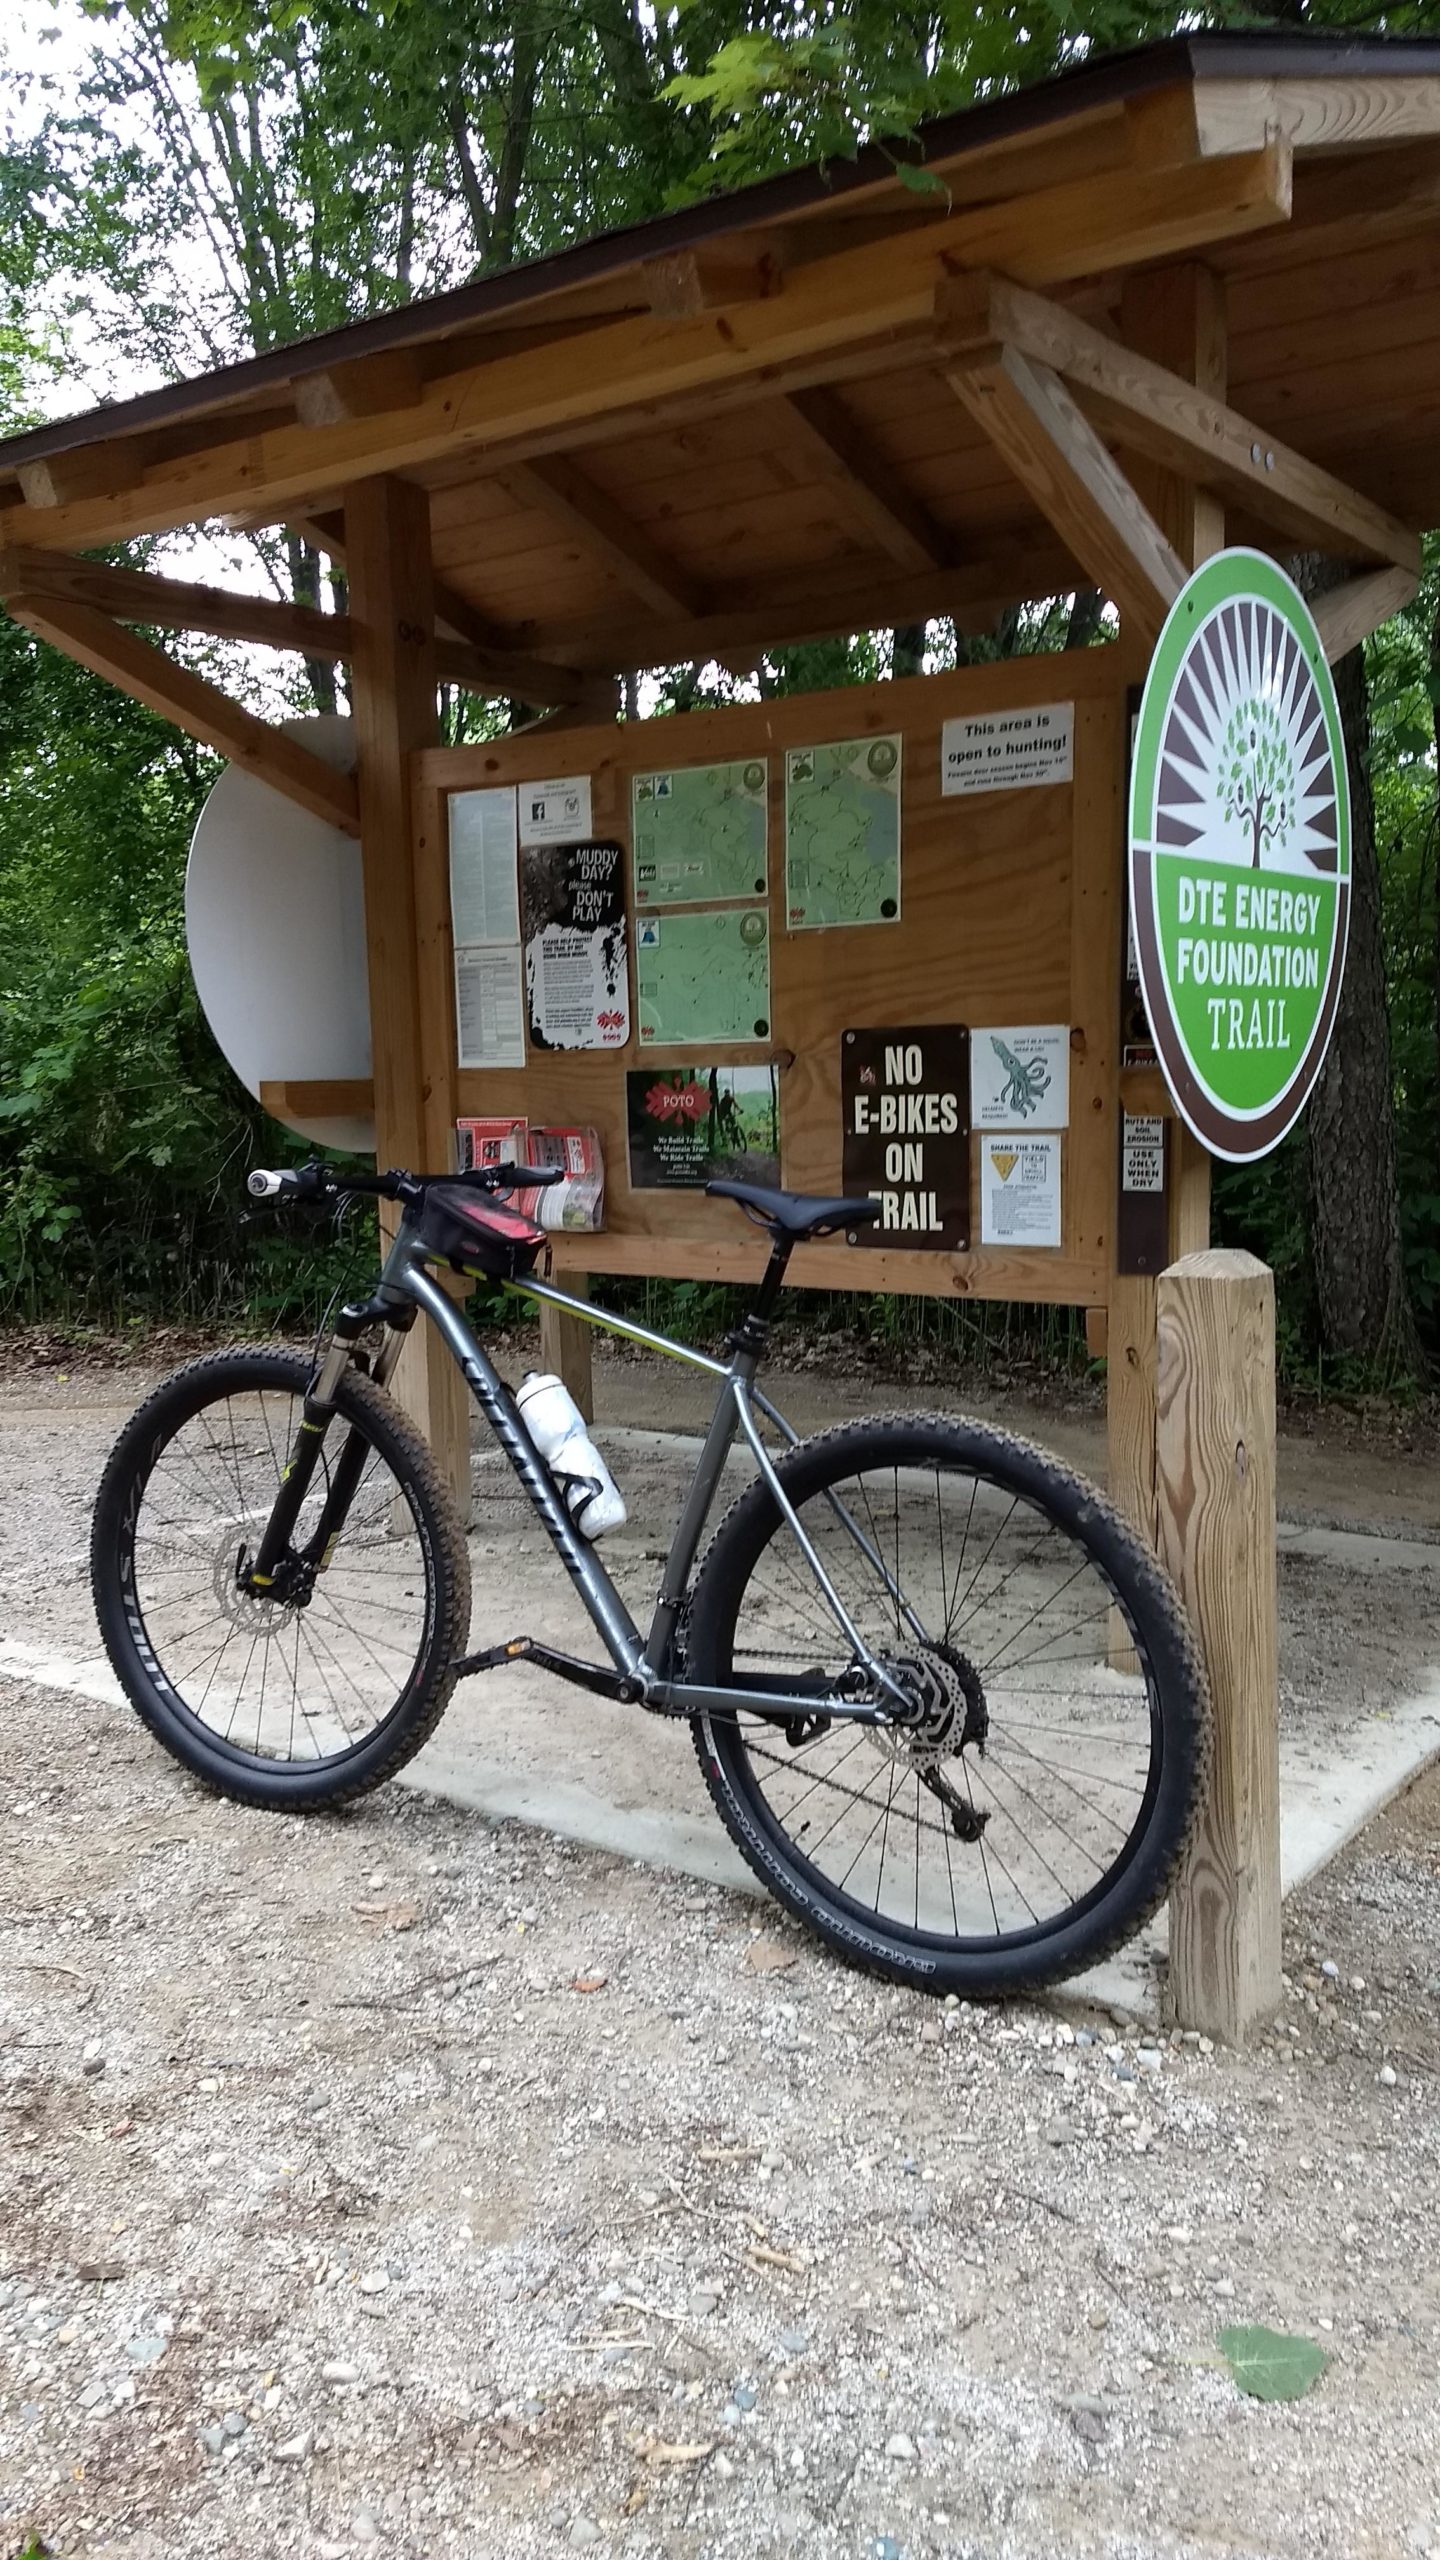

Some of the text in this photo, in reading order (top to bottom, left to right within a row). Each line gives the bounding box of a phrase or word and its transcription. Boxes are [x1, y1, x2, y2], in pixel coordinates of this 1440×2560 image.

[965, 714, 1050, 737] This area is
[948, 734, 1067, 765] open to hunting!
[575, 848, 618, 866] MUDDY
[581, 864, 613, 880] DAY?
[568, 879, 592, 892] please
[576, 889, 613, 907] DON'T
[1178, 876, 1321, 935] DTE ENERGY
[572, 905, 602, 922] PLAY
[1177, 938, 1319, 989] FOUNDATION
[1207, 998, 1291, 1050] TRAIL
[885, 1045, 923, 1085] NO
[663, 1094, 694, 1108] POTO
[854, 1093, 958, 1134] E-BIKES
[1127, 1135, 1160, 1143] EROSION
[1031, 1144, 1051, 1152] TRAIL
[1133, 1150, 1154, 1158] USE
[885, 1143, 923, 1182] ON
[1129, 1160, 1157, 1168] ONLY
[1127, 1169, 1159, 1177] WHEN
[1132, 1179, 1154, 1187] DRY
